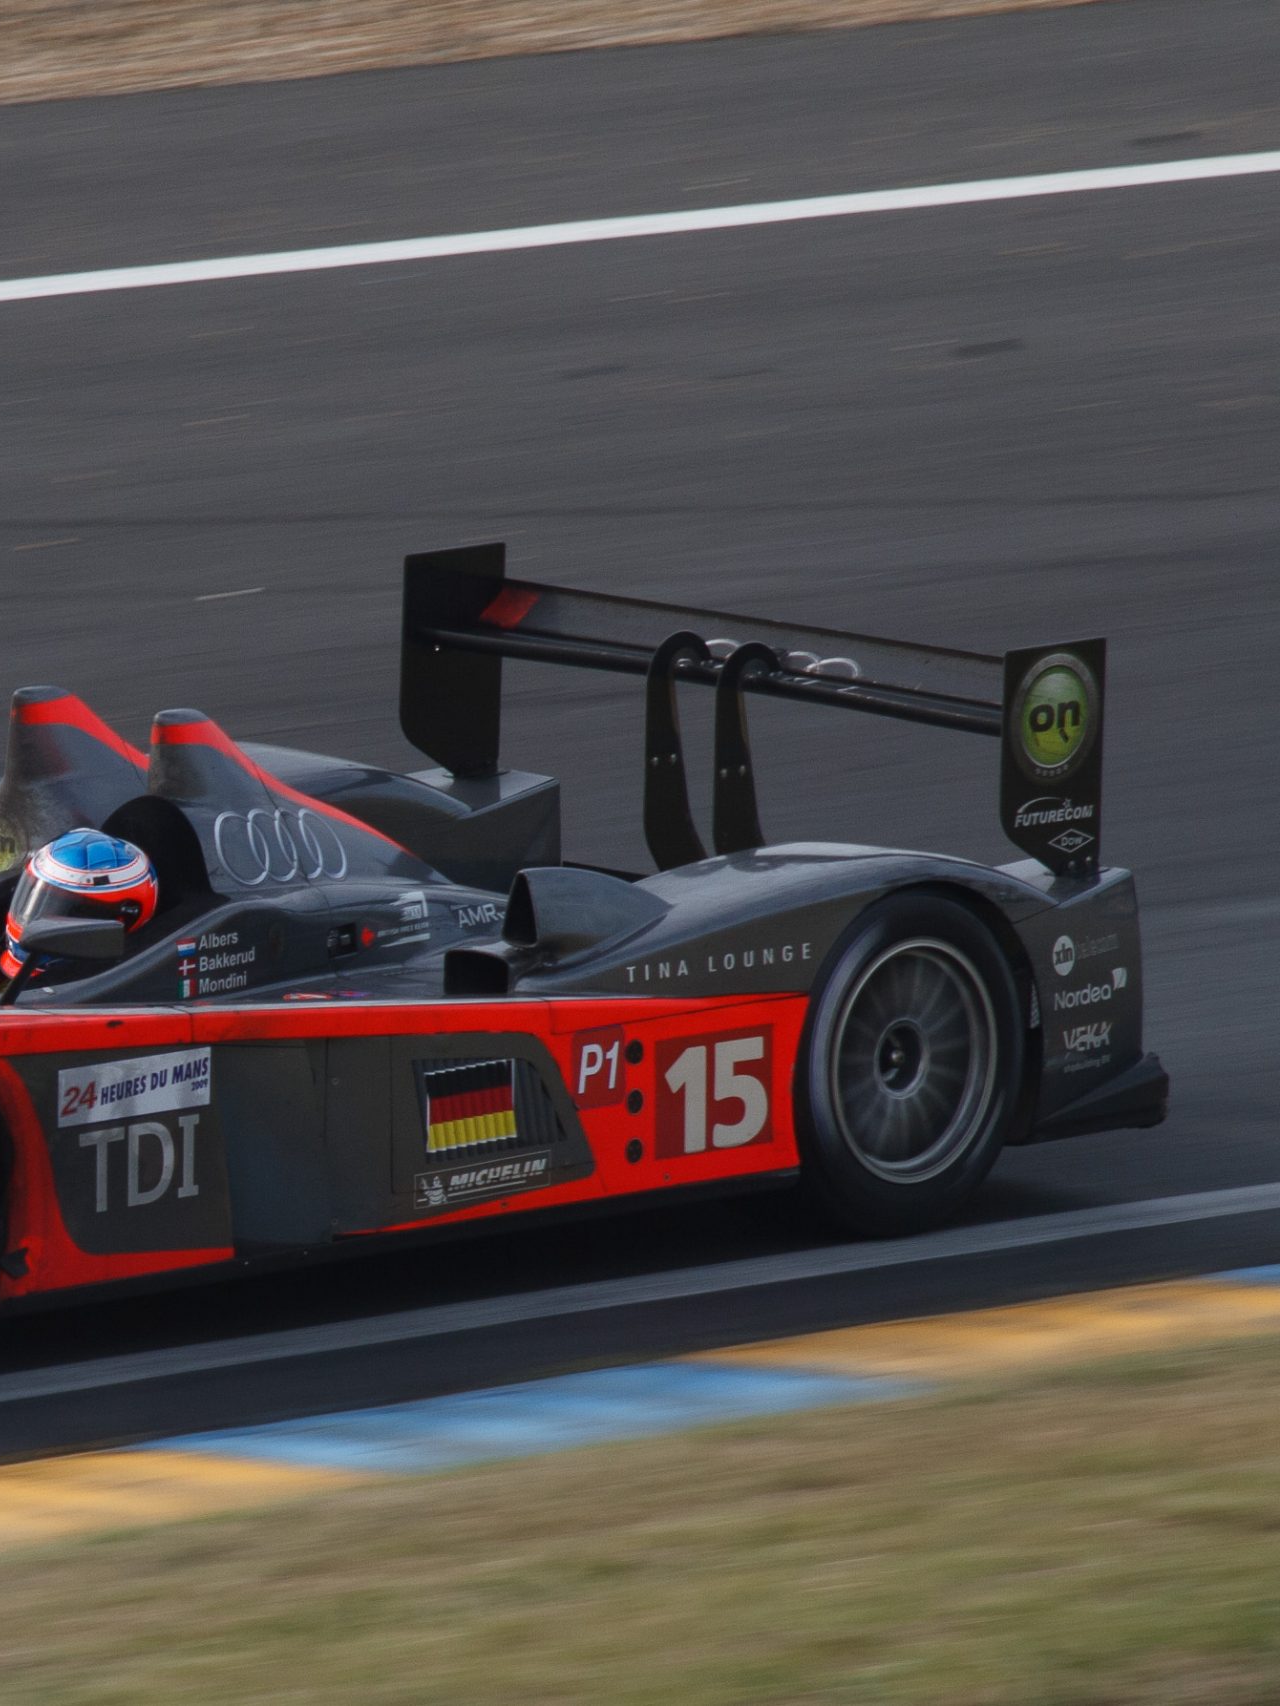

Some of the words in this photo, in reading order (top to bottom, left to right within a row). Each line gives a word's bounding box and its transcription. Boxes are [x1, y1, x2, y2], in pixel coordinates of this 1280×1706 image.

[1029, 701, 1080, 732] on
[1014, 804, 1094, 829] FUTURECOM
[198, 931, 239, 951] Albers
[199, 946, 256, 973] Bakkerud
[626, 960, 689, 984] TINA
[708, 942, 811, 973] LOUNGE
[198, 970, 248, 995] Mondini
[1053, 983, 1112, 1011] Nordea
[578, 1040, 620, 1095] P1
[60, 1080, 98, 1118] 24
[100, 1074, 147, 1106] HEURES
[150, 1068, 169, 1091] DU
[171, 1056, 209, 1086] MANS
[664, 1035, 769, 1154] 15
[78, 1113, 200, 1213] TDI
[449, 1157, 548, 1188] MICHELIN
